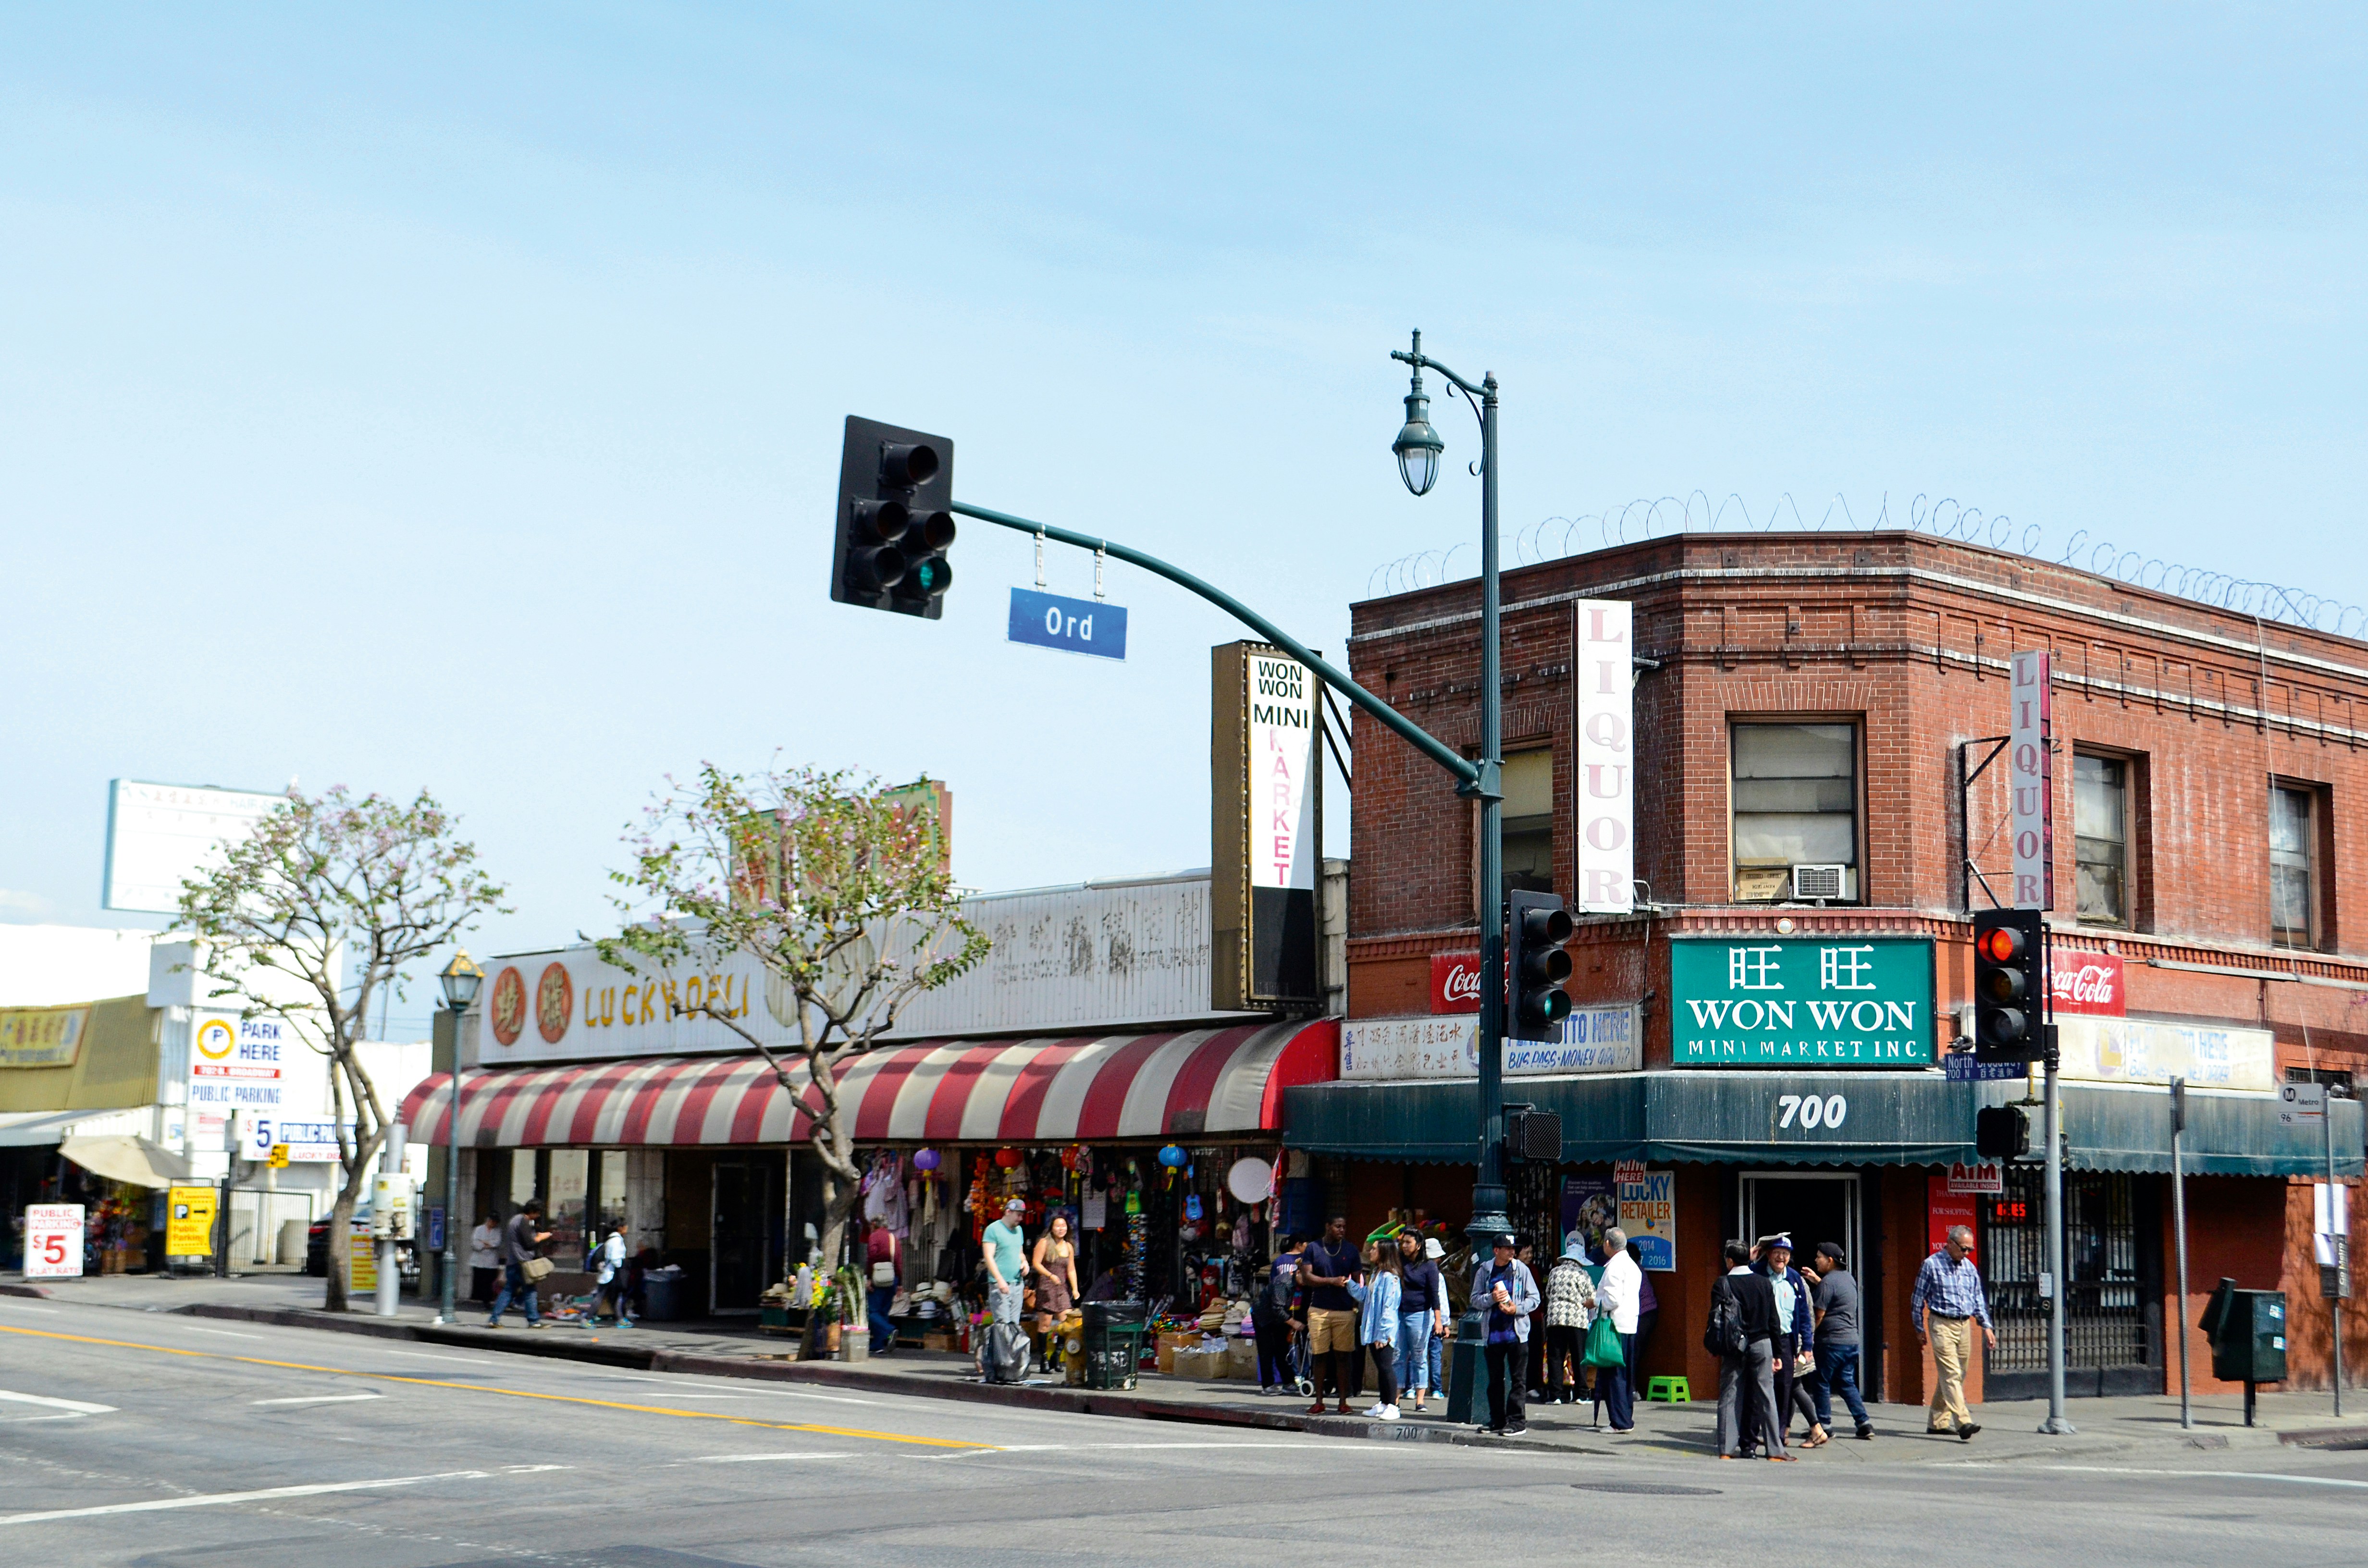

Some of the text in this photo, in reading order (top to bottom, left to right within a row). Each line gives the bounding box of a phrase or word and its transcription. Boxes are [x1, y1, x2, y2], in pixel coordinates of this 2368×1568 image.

[1258, 661, 1302, 682] WON
[1258, 678, 1302, 699] WON
[1255, 704, 1307, 728] MINI
[1585, 608, 1628, 905] LIQUOR
[2015, 659, 2039, 904] LIQUOR
[1046, 607, 1092, 1121] Ord
[585, 980, 676, 1027] LUCKY
[687, 973, 749, 1019] DELI
[1686, 1000, 1916, 1031] WON WON
[242, 1022, 282, 1039] PARK
[1592, 1011, 1628, 1042] HERE
[240, 1044, 281, 1061] HERE
[1689, 1040, 1926, 1057] MINI MARKET INC.
[1508, 1052, 1529, 1069] BUS
[1948, 1055, 1973, 1069] North
[1948, 1069, 1969, 1078] 700 N
[193, 1085, 282, 1104] PUBLIC PARKING
[1779, 1094, 1846, 1129] 700
[2281, 1114, 2291, 1122] 96
[283, 1124, 318, 1142] PUBLIC
[1617, 1172, 1642, 1181] HERE
[1621, 1176, 1670, 1200] LUCKY
[1622, 1202, 1670, 1219] RETAILER
[1946, 1207, 1972, 1216] SHOPPING
[32, 1220, 78, 1229] PARKING
[173, 1235, 205, 1243] Parking
[1639, 1240, 1654, 1251] 2014
[1649, 1256, 1666, 1265] 2016
[2339, 1272, 2346, 1286] Go
[1396, 1426, 1418, 1441] 700
